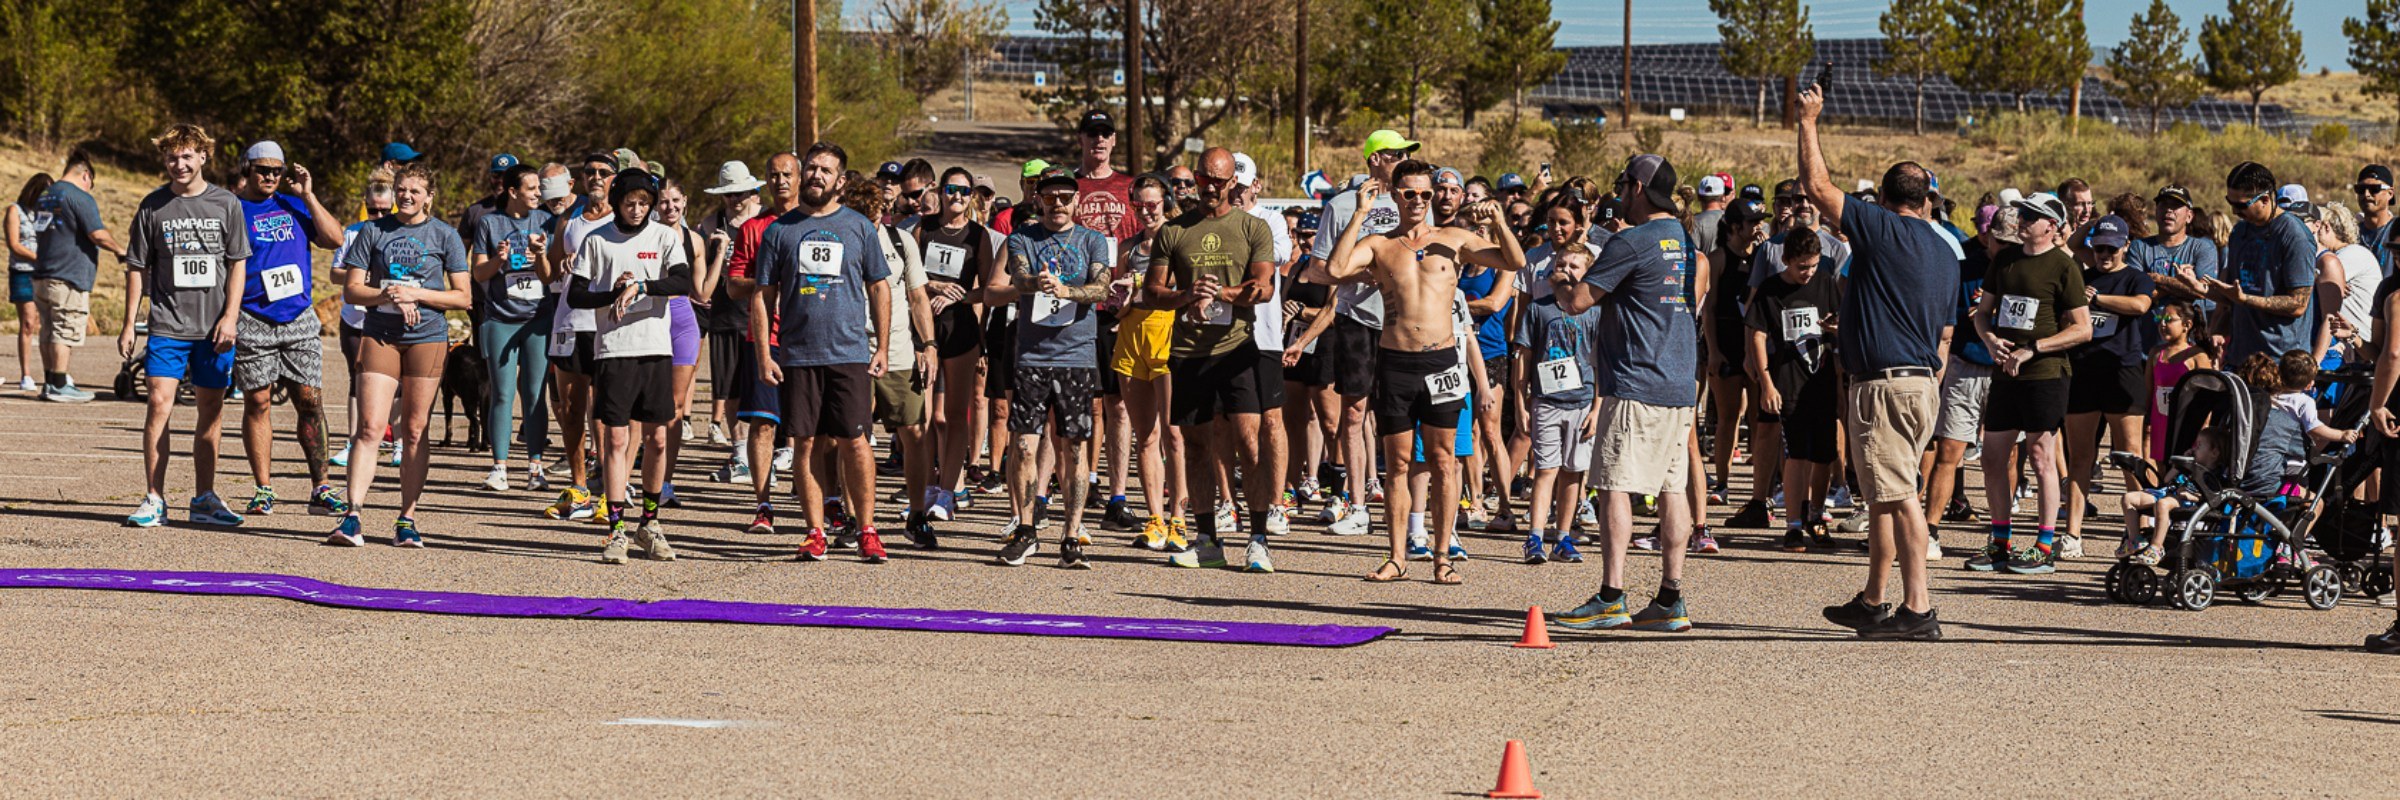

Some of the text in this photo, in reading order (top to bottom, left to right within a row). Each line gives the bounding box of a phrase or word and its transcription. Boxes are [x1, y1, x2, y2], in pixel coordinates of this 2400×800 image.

[162, 217, 221, 232] RAMPAGE
[174, 230, 220, 242] HOCKEY
[272, 227, 295, 242] 10K
[812, 247, 831, 262] 83
[939, 250, 952, 264] 11
[182, 260, 208, 275] 106
[271, 270, 295, 288] 214
[516, 277, 532, 290] 62
[1050, 299, 1060, 314] 3
[2009, 302, 2027, 317] 49
[1791, 313, 1811, 328] 175
[1551, 364, 1568, 380] 12
[1434, 372, 1460, 393] 209
